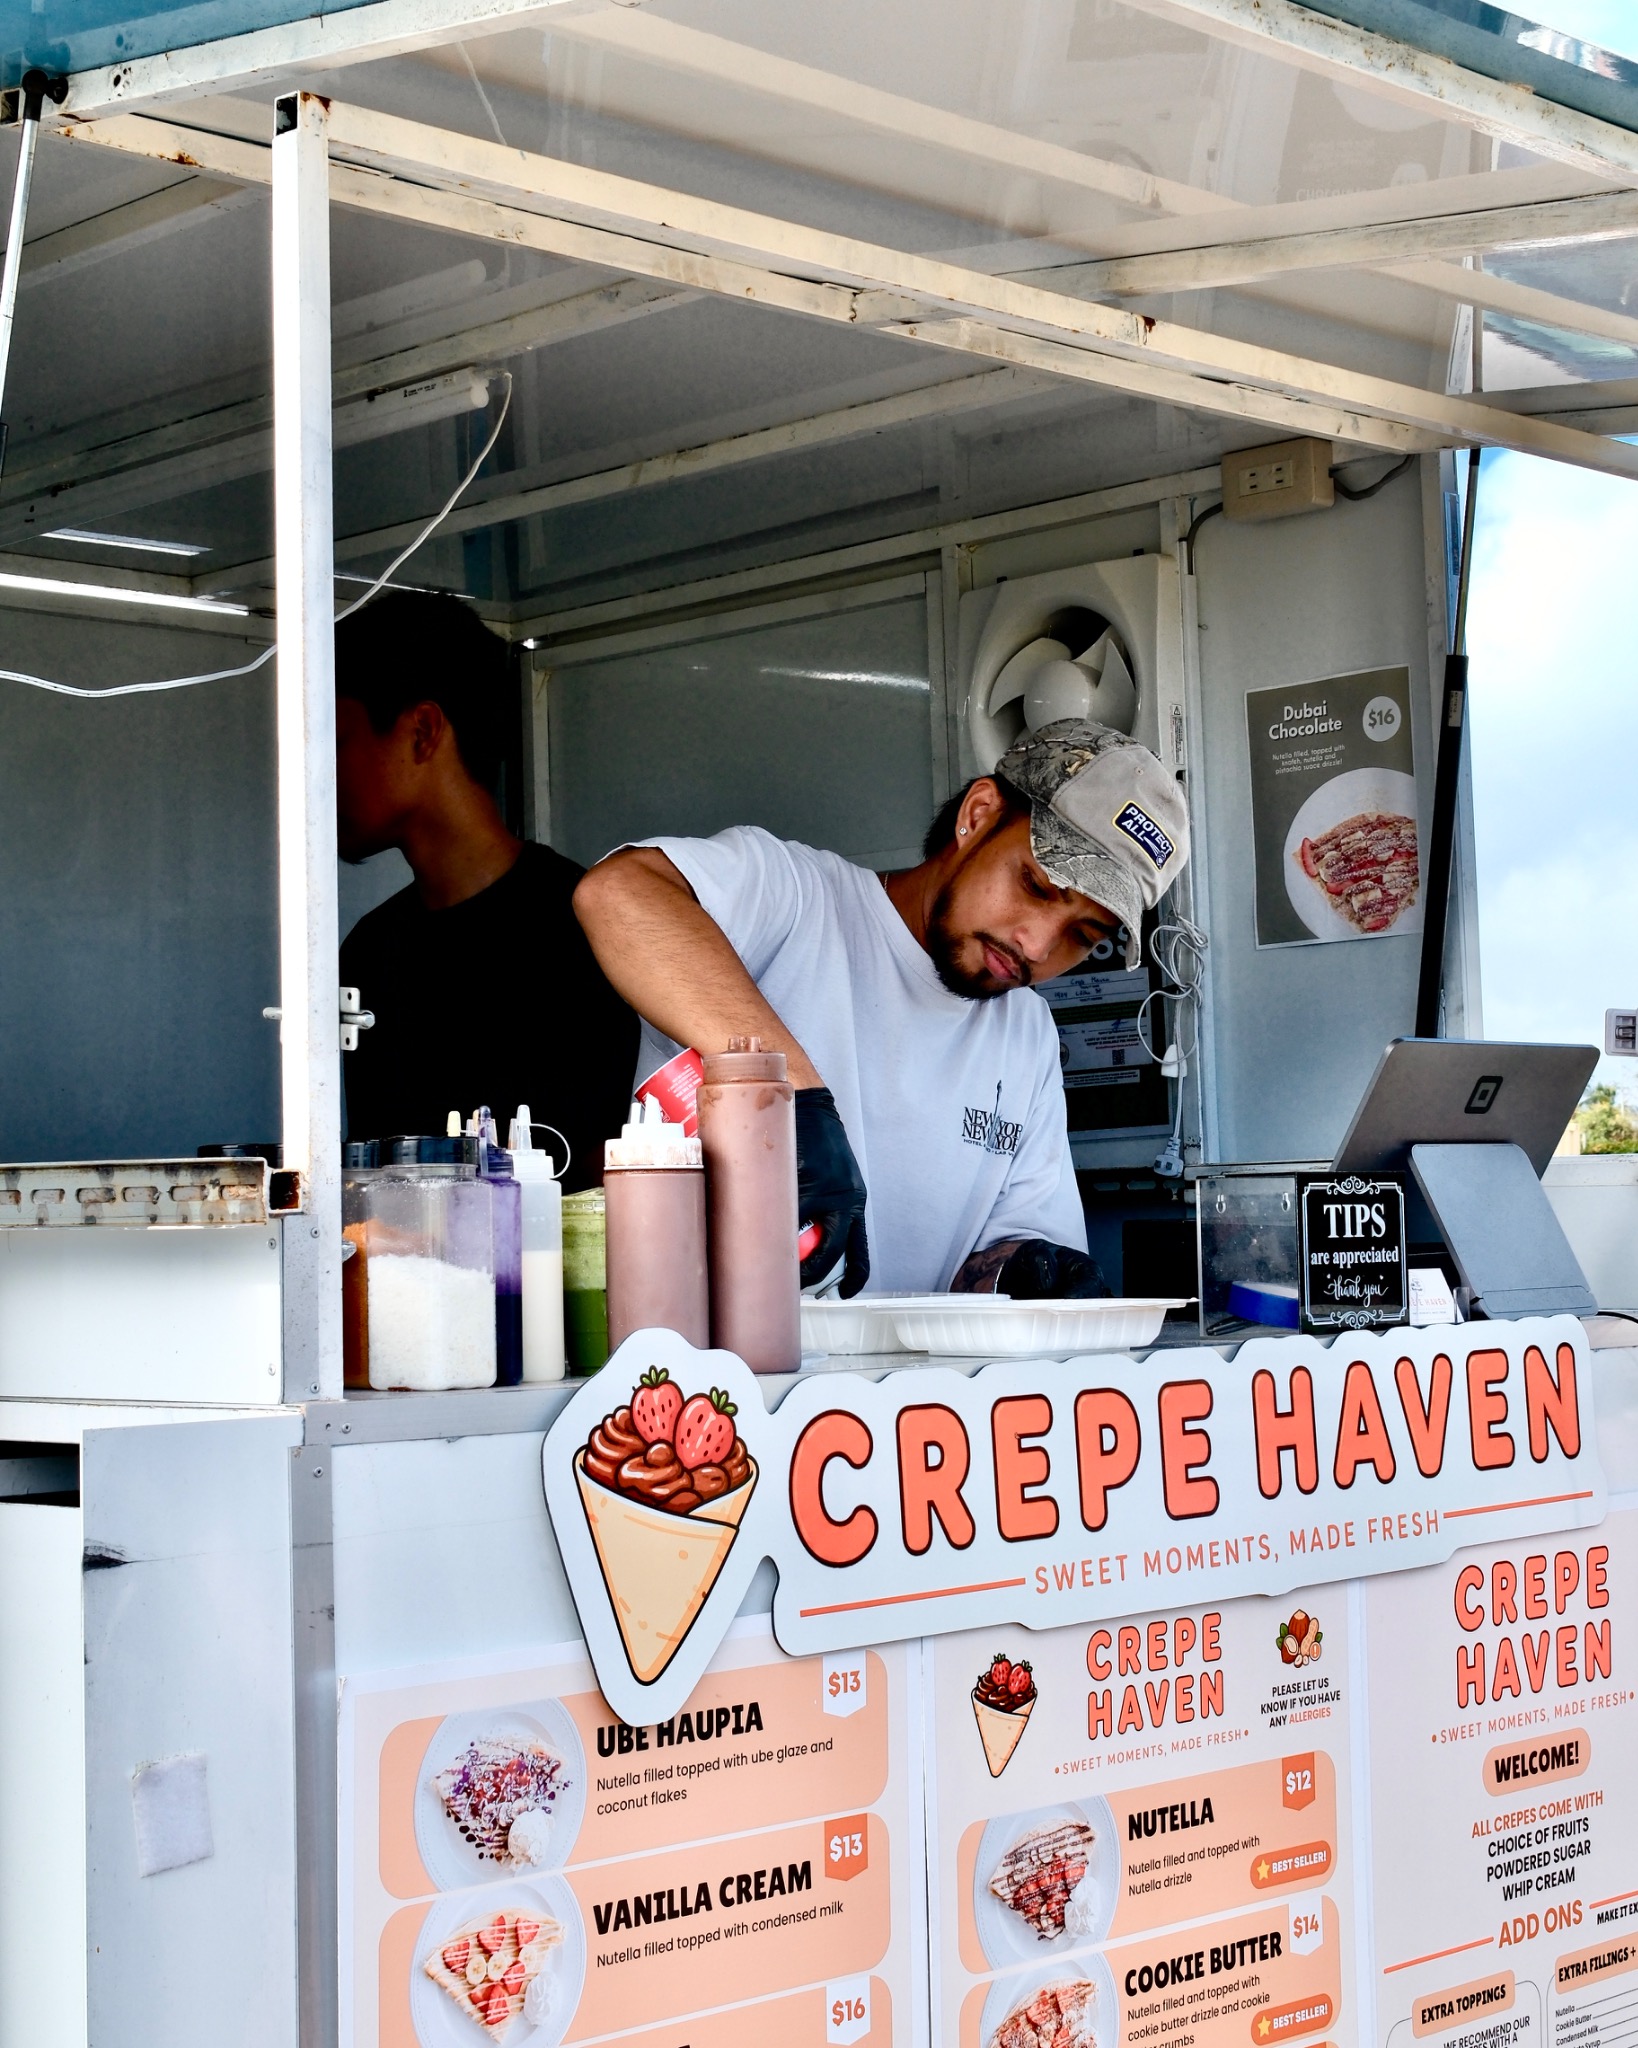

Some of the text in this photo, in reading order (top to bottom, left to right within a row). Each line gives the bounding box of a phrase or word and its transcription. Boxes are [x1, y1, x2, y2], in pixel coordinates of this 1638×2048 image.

[1283, 700, 1327, 722] Dubai
[1368, 708, 1395, 729] $16
[1268, 719, 1343, 740] Chocolate
[1311, 746, 1332, 754] topped
[1122, 819, 1145, 841] ALL
[1125, 806, 1172, 854] PROTECT
[1323, 1203, 1386, 1239] TIPS
[1310, 1246, 1400, 1268] are appreciated
[787, 1341, 1583, 1569] CREPE HAVEN
[1034, 1509, 1441, 1596] SWEET MOMENTS, MADE FRESH
[1454, 1545, 1610, 1632] CREPE
[1086, 1612, 1222, 1681] CREPE
[1456, 1618, 1612, 1709] HAVEN
[827, 1669, 862, 1697] $13
[1272, 1677, 1329, 1697] PLEASE LET US
[1087, 1669, 1224, 1741] HAVEN
[1260, 1690, 1341, 1715] KNOW IF YOU HAVE
[1269, 1707, 1331, 1728] ANY ALLERGIES
[1440, 1691, 1627, 1744] SWEET MOMENTS, MADE FRESH
[596, 1701, 764, 1758] UBE HAUPIA
[596, 1737, 834, 1791] Nutella filled topped with ube glaze and
[1062, 1729, 1242, 1775] SWEET MOMENTS, MADE FRESH
[1495, 1741, 1579, 1783] WELCOME!
[1286, 1770, 1312, 1795] $12
[596, 1787, 688, 1816] coconut flakes
[1128, 1797, 1215, 1841] NUTELLA
[1472, 1790, 1603, 1839] ALL CREPES COME WITH
[829, 1833, 863, 1863] $13
[1488, 1817, 1589, 1857] CHOICE OF FRUITS
[1128, 1835, 1260, 1876] Nutella filled and topped with
[1272, 1850, 1327, 1873] BEST SELLER!
[1487, 1840, 1591, 1882] POWDERED SUGAR
[593, 1860, 812, 1936] VANILLA CREAM
[1128, 1872, 1192, 1896] Nutella drizzle
[1502, 1866, 1575, 1901] WHIP CREAM
[1293, 1914, 1319, 1939] $14
[1499, 1899, 1583, 1949] ADD ONS
[1597, 1908, 1618, 1925] MAKE
[1620, 1905, 1628, 1918] IT
[596, 1901, 844, 1968] Nutella filled topped with condensed milk
[1124, 1931, 1283, 1997] COOKIE BUTTER
[1558, 1960, 1588, 1983] EXTRA
[1589, 1946, 1629, 1972] FILLINGS
[832, 1997, 866, 2027] $16
[1127, 1975, 1261, 2021] Nutella filled and topped with
[1421, 1983, 1506, 2025] EXTRA TOPPINGS
[1555, 2005, 1576, 2018] Nutella
[1128, 1992, 1271, 2042] cookie butter drizzle and cookie
[1273, 2003, 1328, 2029] BEST SELLER!
[1458, 2024, 1512, 2048] RECOMMEND
[1513, 2016, 1530, 2033] OUR
[1555, 2013, 1592, 2032] Cookie Butter
[1158, 2034, 1195, 2048] crumbs
[1489, 2035, 1511, 2048] WITH
[1512, 2032, 1518, 2043] A
[1555, 2024, 1599, 2046] Condensed Milk
